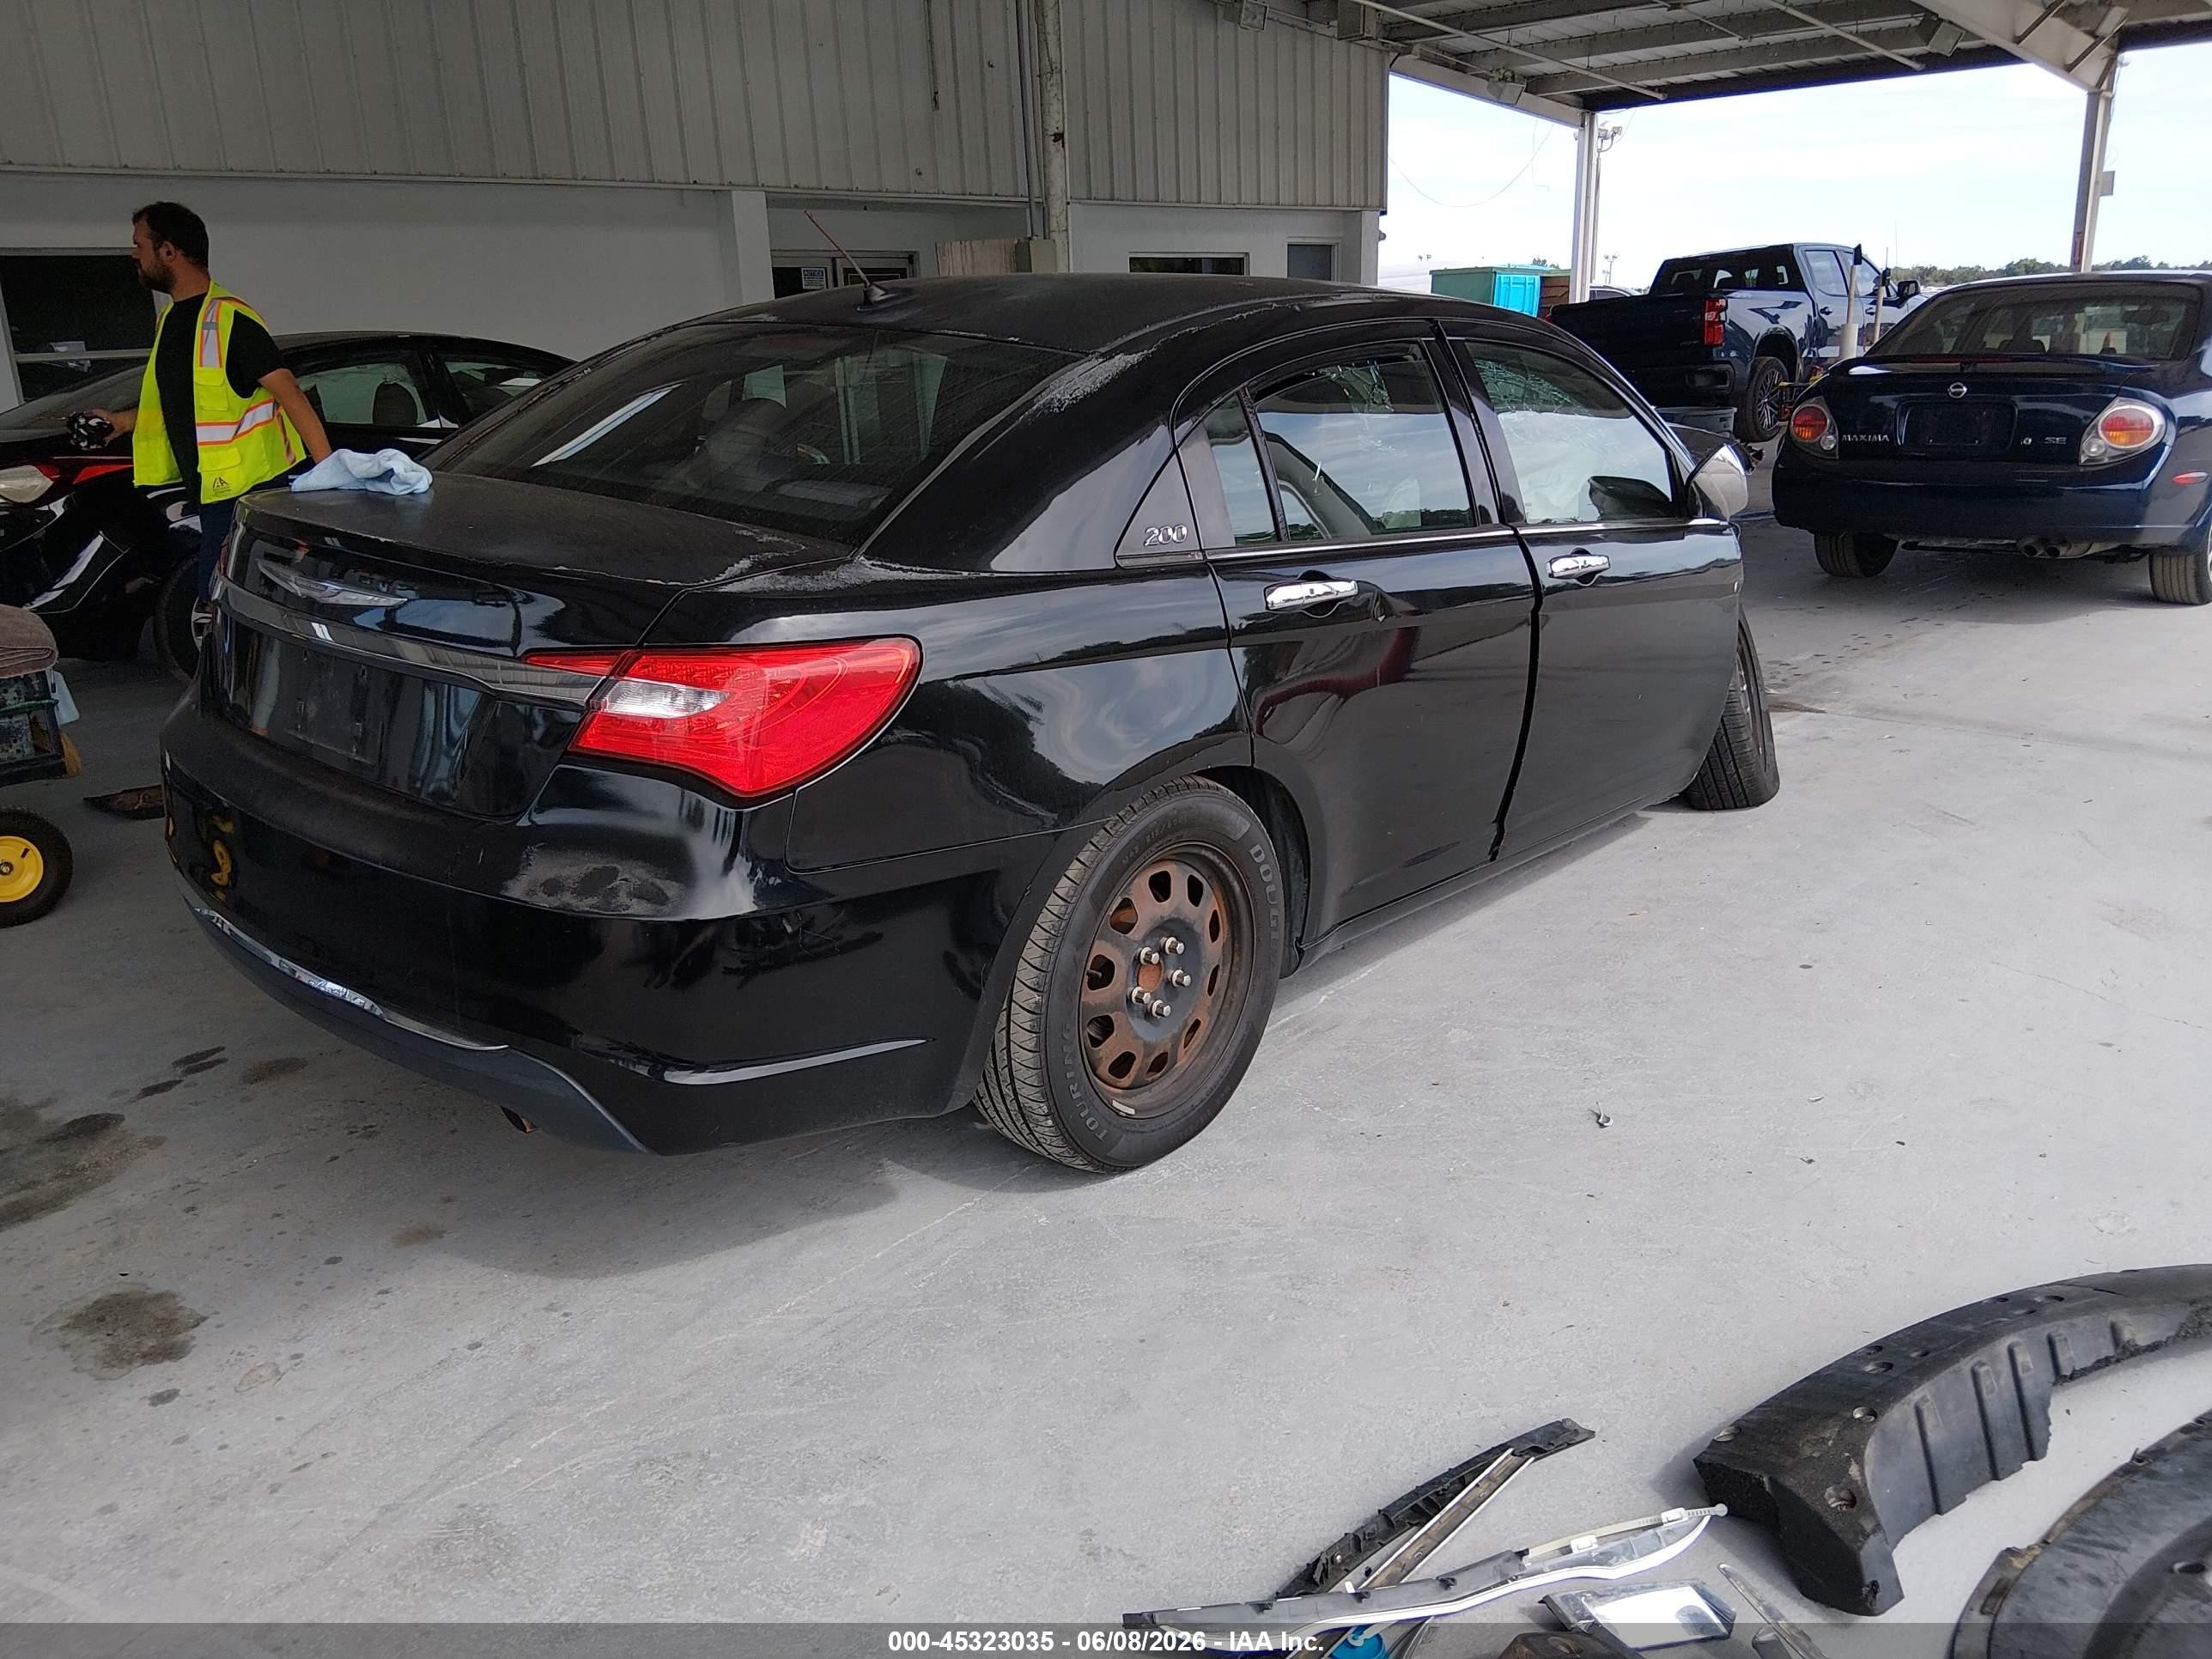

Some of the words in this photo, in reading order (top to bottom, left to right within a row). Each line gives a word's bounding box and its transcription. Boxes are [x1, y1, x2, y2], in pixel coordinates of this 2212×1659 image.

[1842, 434, 1890, 442] MAXIMA
[2044, 436, 2068, 445] SE
[1144, 525, 1188, 546] 200
